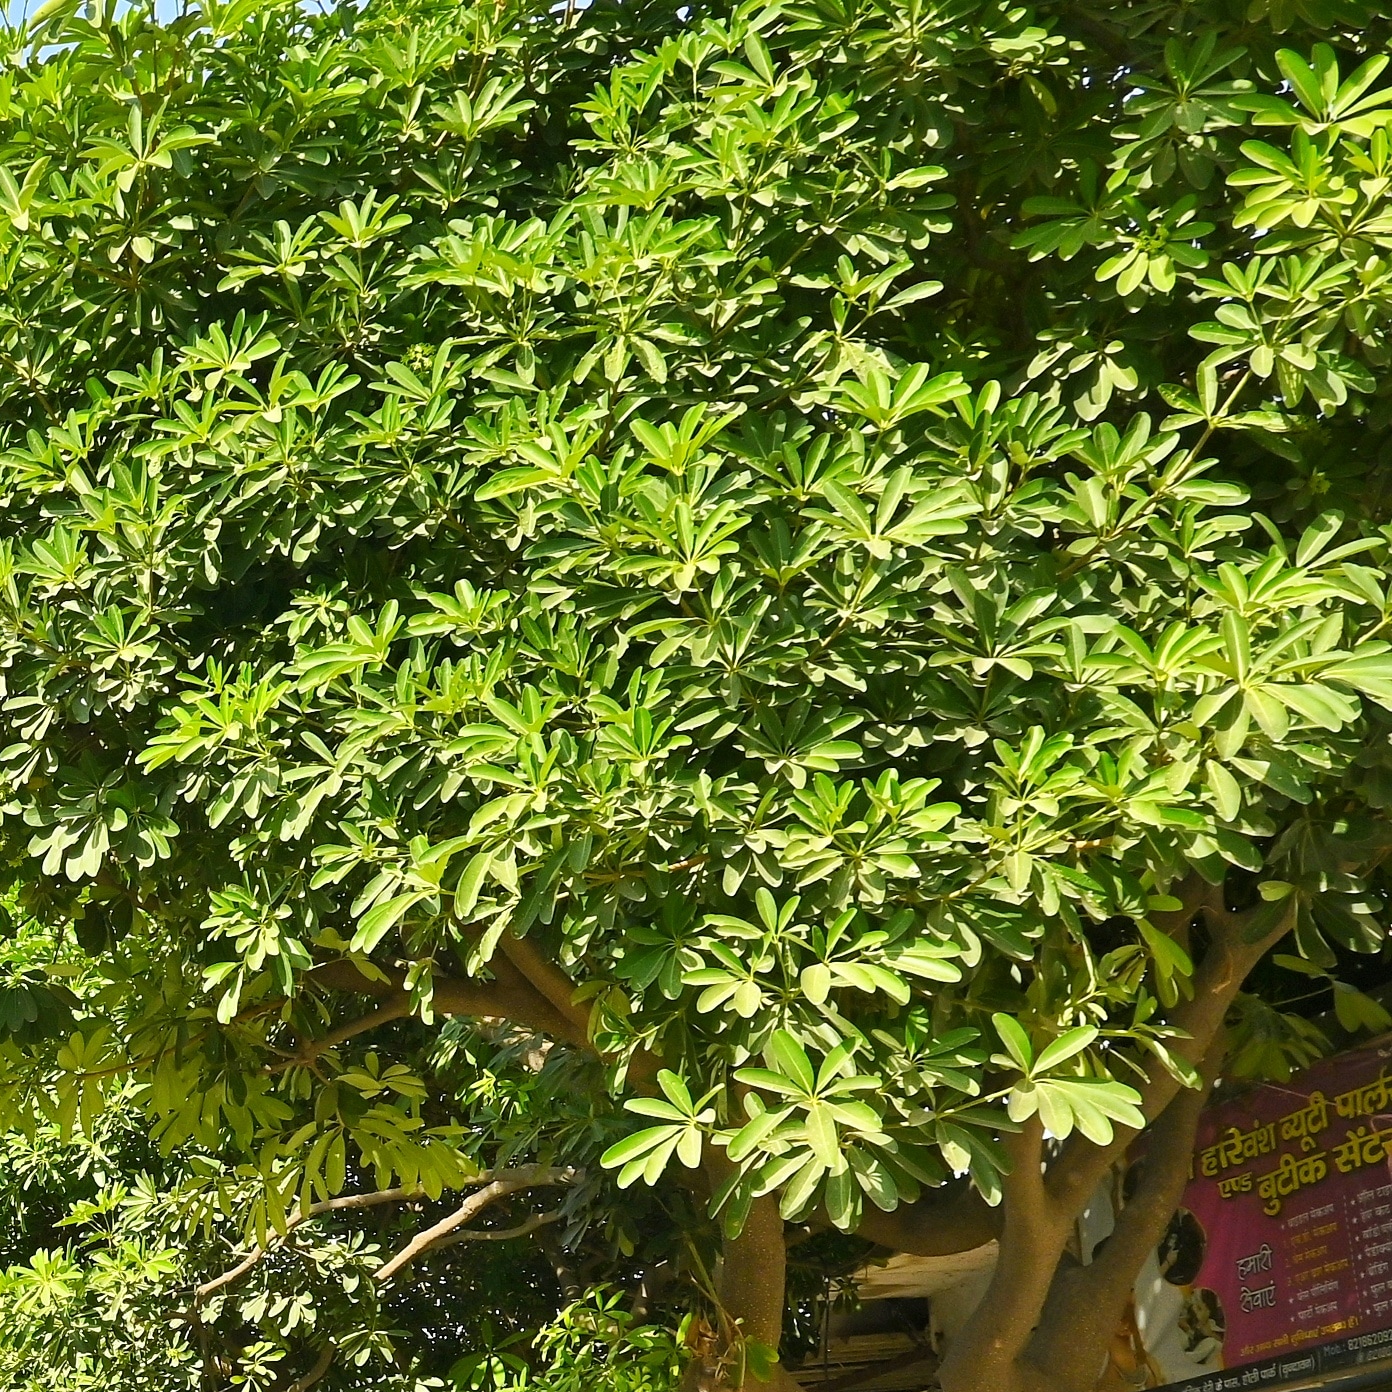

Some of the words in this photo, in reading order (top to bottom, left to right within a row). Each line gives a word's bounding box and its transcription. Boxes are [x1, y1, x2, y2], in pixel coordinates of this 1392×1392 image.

[1218, 1172, 1253, 1198] एण्ड
[1257, 1152, 1327, 1216] बुटीक
[1236, 1243, 1273, 1280] हमारी
